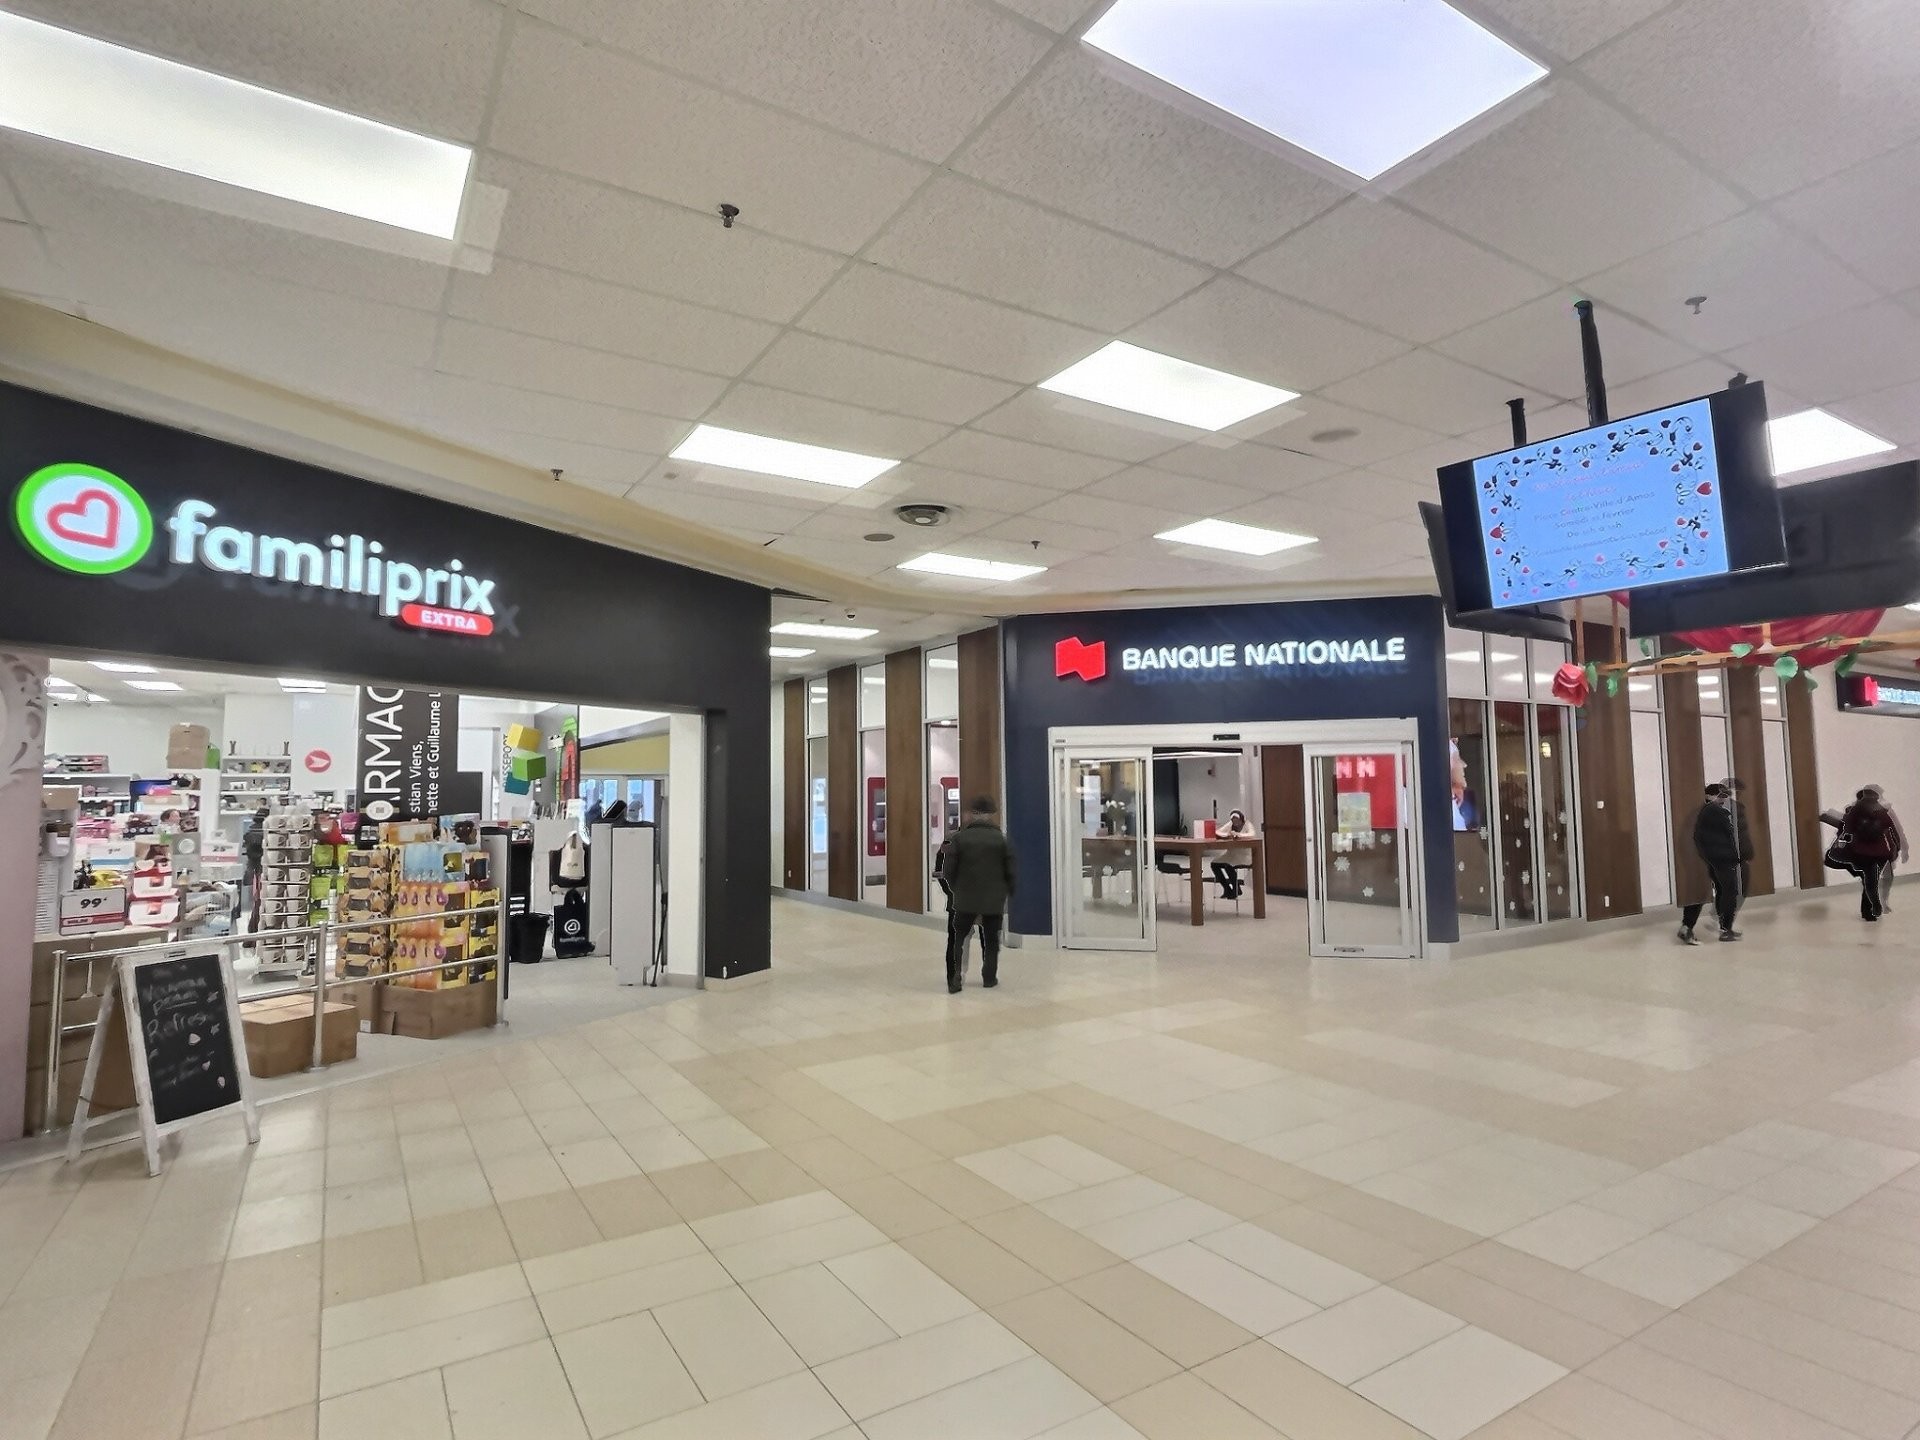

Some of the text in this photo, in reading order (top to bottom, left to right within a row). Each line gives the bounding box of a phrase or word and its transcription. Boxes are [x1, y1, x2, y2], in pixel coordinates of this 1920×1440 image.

[168, 499, 496, 616] familiprix
[420, 609, 478, 631] EXTRA
[1122, 637, 1406, 671] BANQUE NATIONALE
[364, 686, 404, 801] RMAC
[426, 700, 441, 763] Guillaume
[409, 740, 424, 779] Viens,
[427, 766, 439, 780] et
